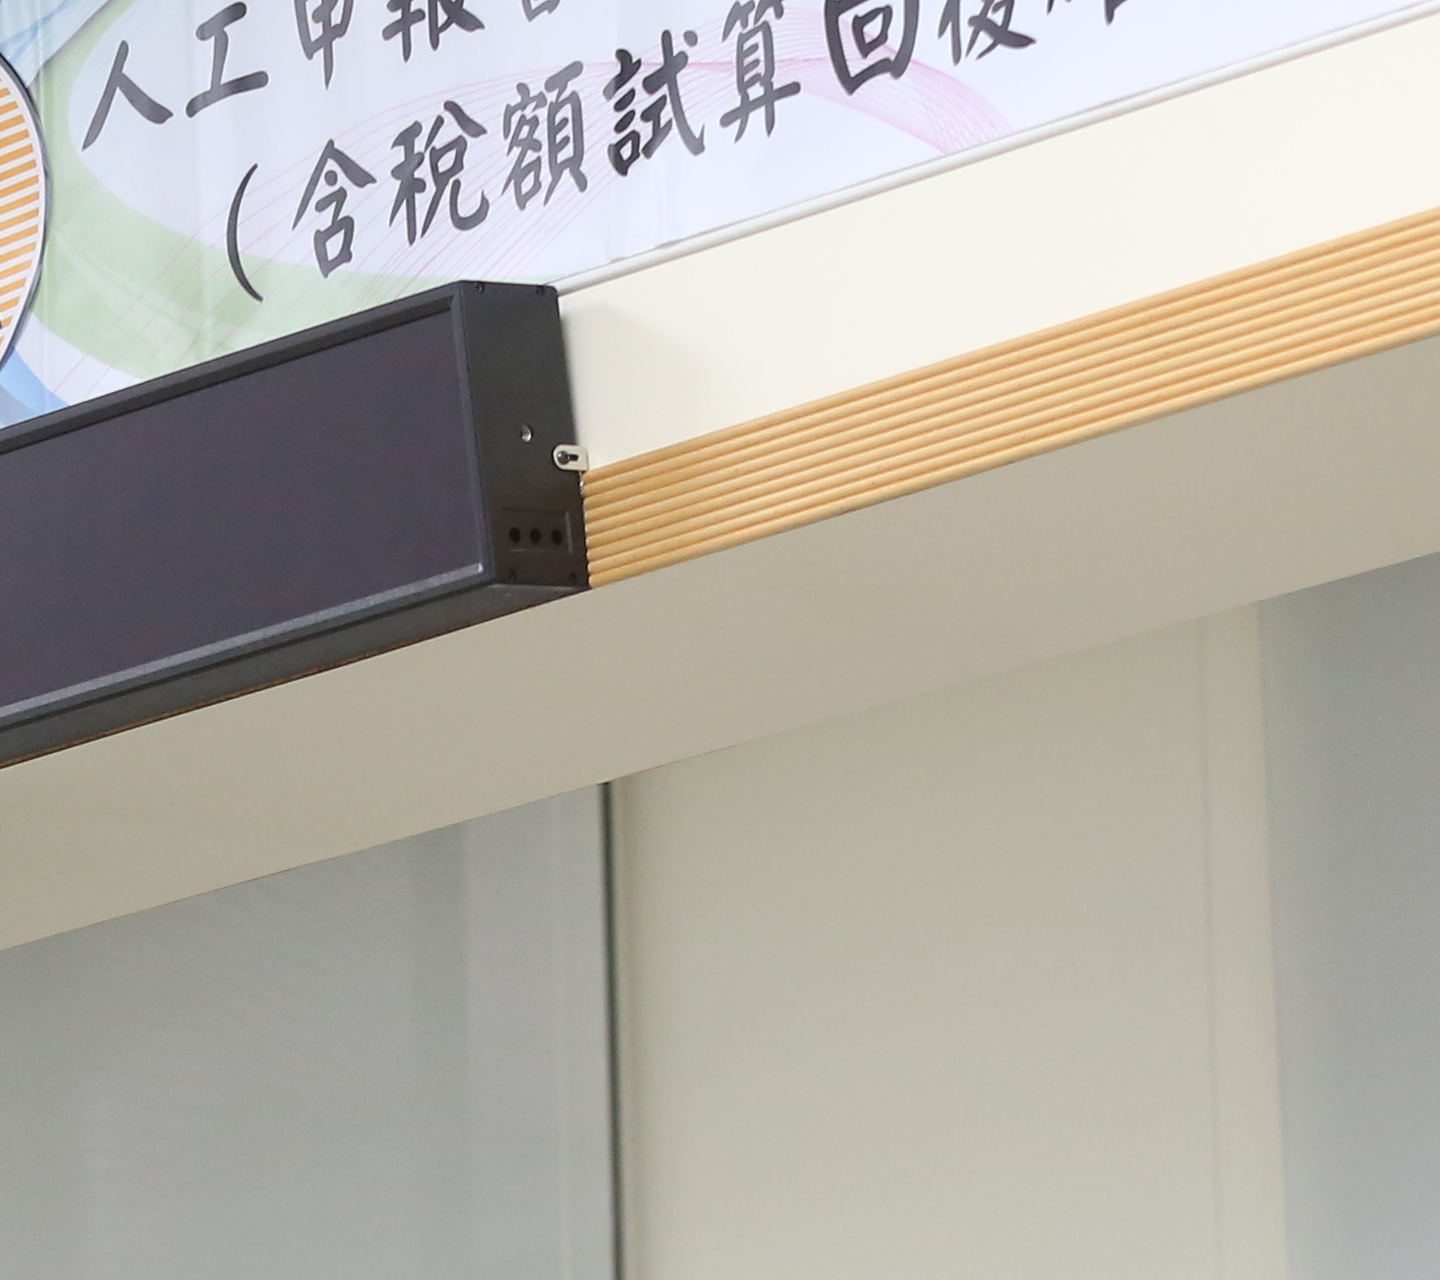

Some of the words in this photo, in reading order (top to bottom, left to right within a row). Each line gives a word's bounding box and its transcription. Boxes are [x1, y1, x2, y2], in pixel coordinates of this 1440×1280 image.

[226, 0, 1123, 302] (含稅額試算回
